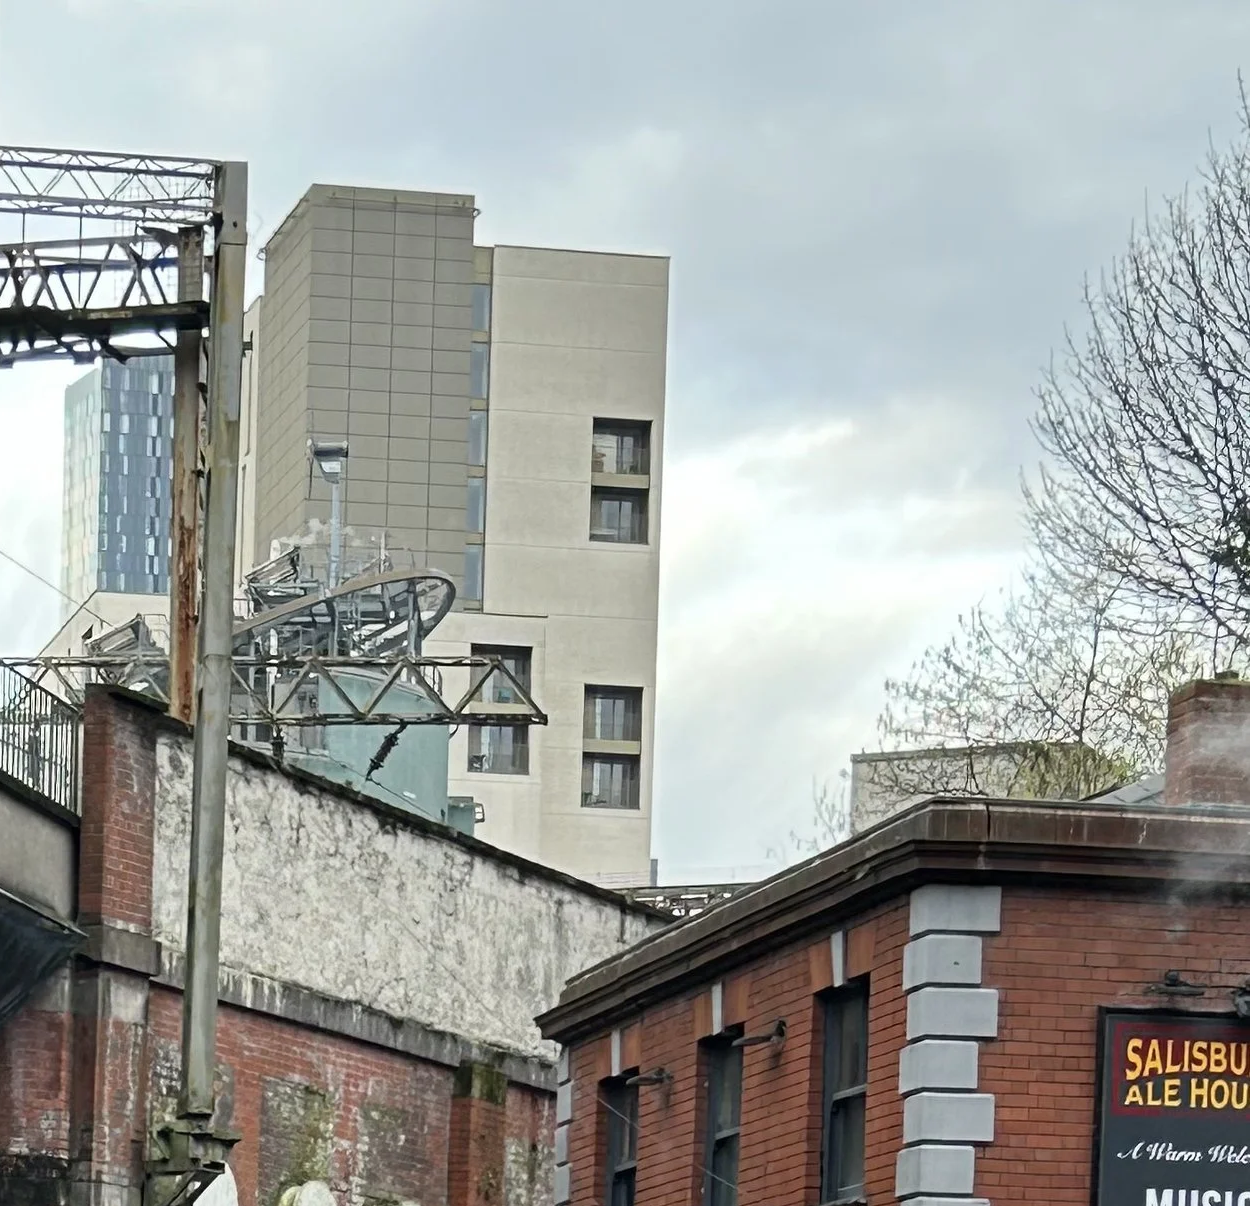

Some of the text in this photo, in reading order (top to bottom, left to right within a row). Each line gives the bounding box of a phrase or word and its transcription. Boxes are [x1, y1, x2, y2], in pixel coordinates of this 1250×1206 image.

[1125, 1038, 1250, 1080] SALISBU
[1124, 1078, 1249, 1110] ALE HOU
[1146, 1142, 1202, 1162] Warm
